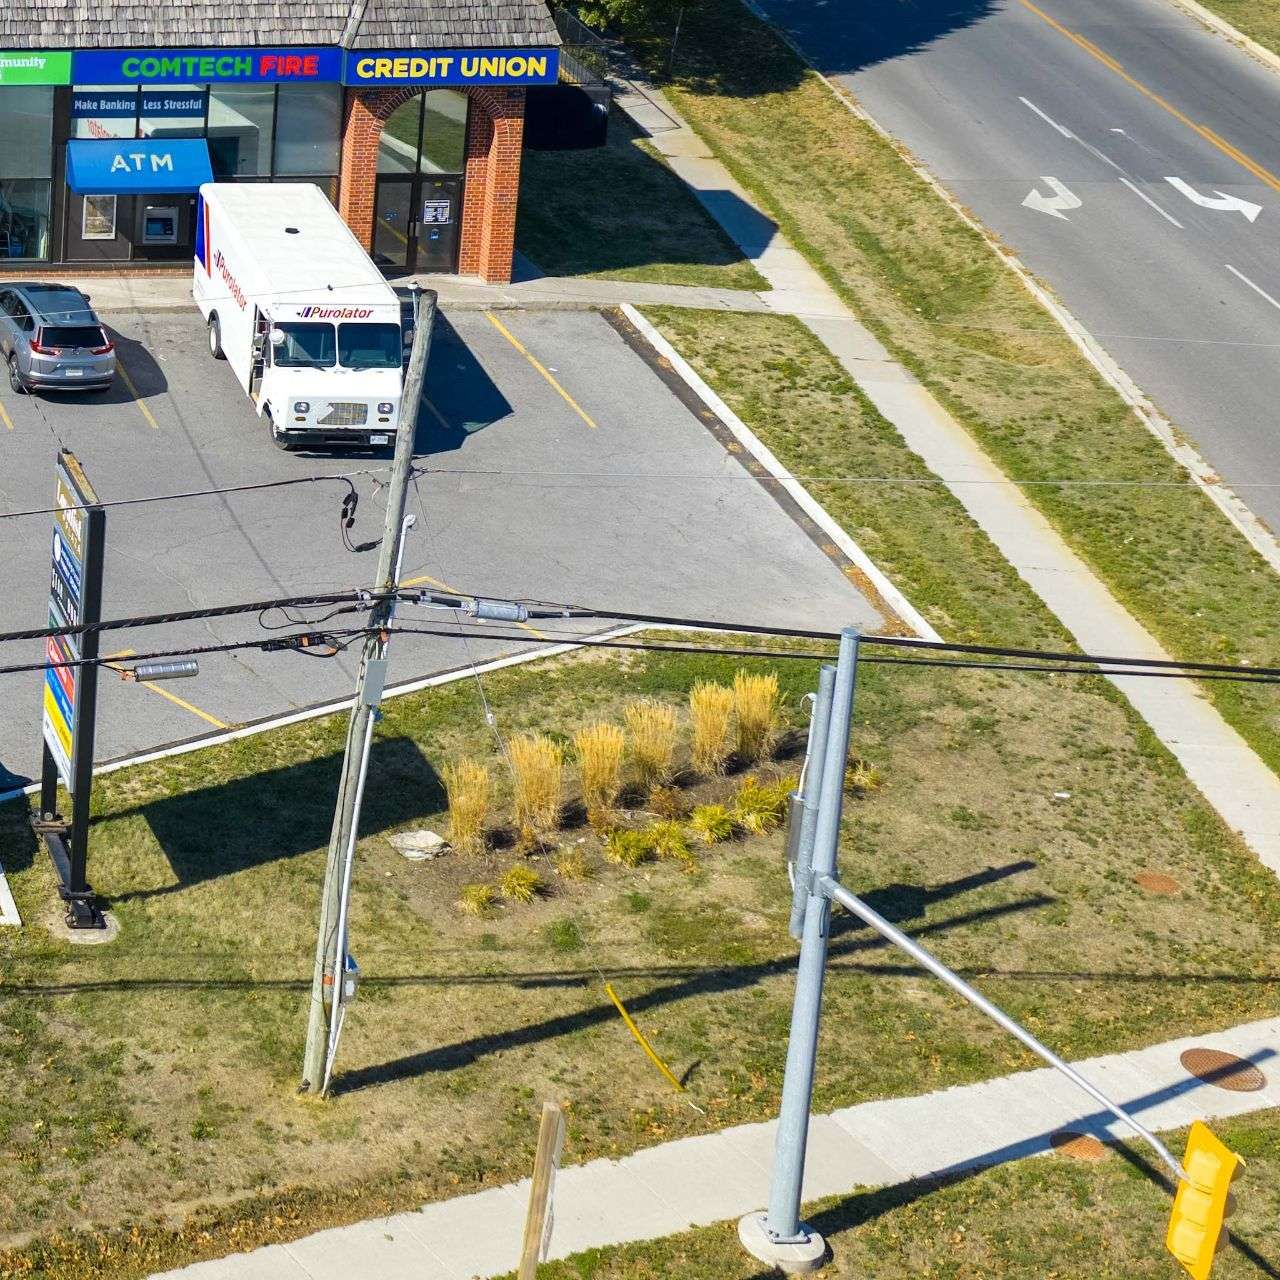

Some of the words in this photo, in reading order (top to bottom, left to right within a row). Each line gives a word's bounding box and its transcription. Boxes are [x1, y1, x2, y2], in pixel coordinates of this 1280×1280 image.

[121, 56, 252, 77] COMTECH
[259, 55, 319, 76] FIRE
[356, 56, 453, 78] CREDIT
[460, 56, 547, 77] UNION
[74, 100, 98, 110] Make
[100, 100, 136, 111] Banking
[143, 100, 161, 110] Less
[164, 99, 202, 110] Stressful
[110, 153, 174, 173] ATM
[219, 257, 247, 312] Purolator
[311, 306, 374, 319] Purolator
